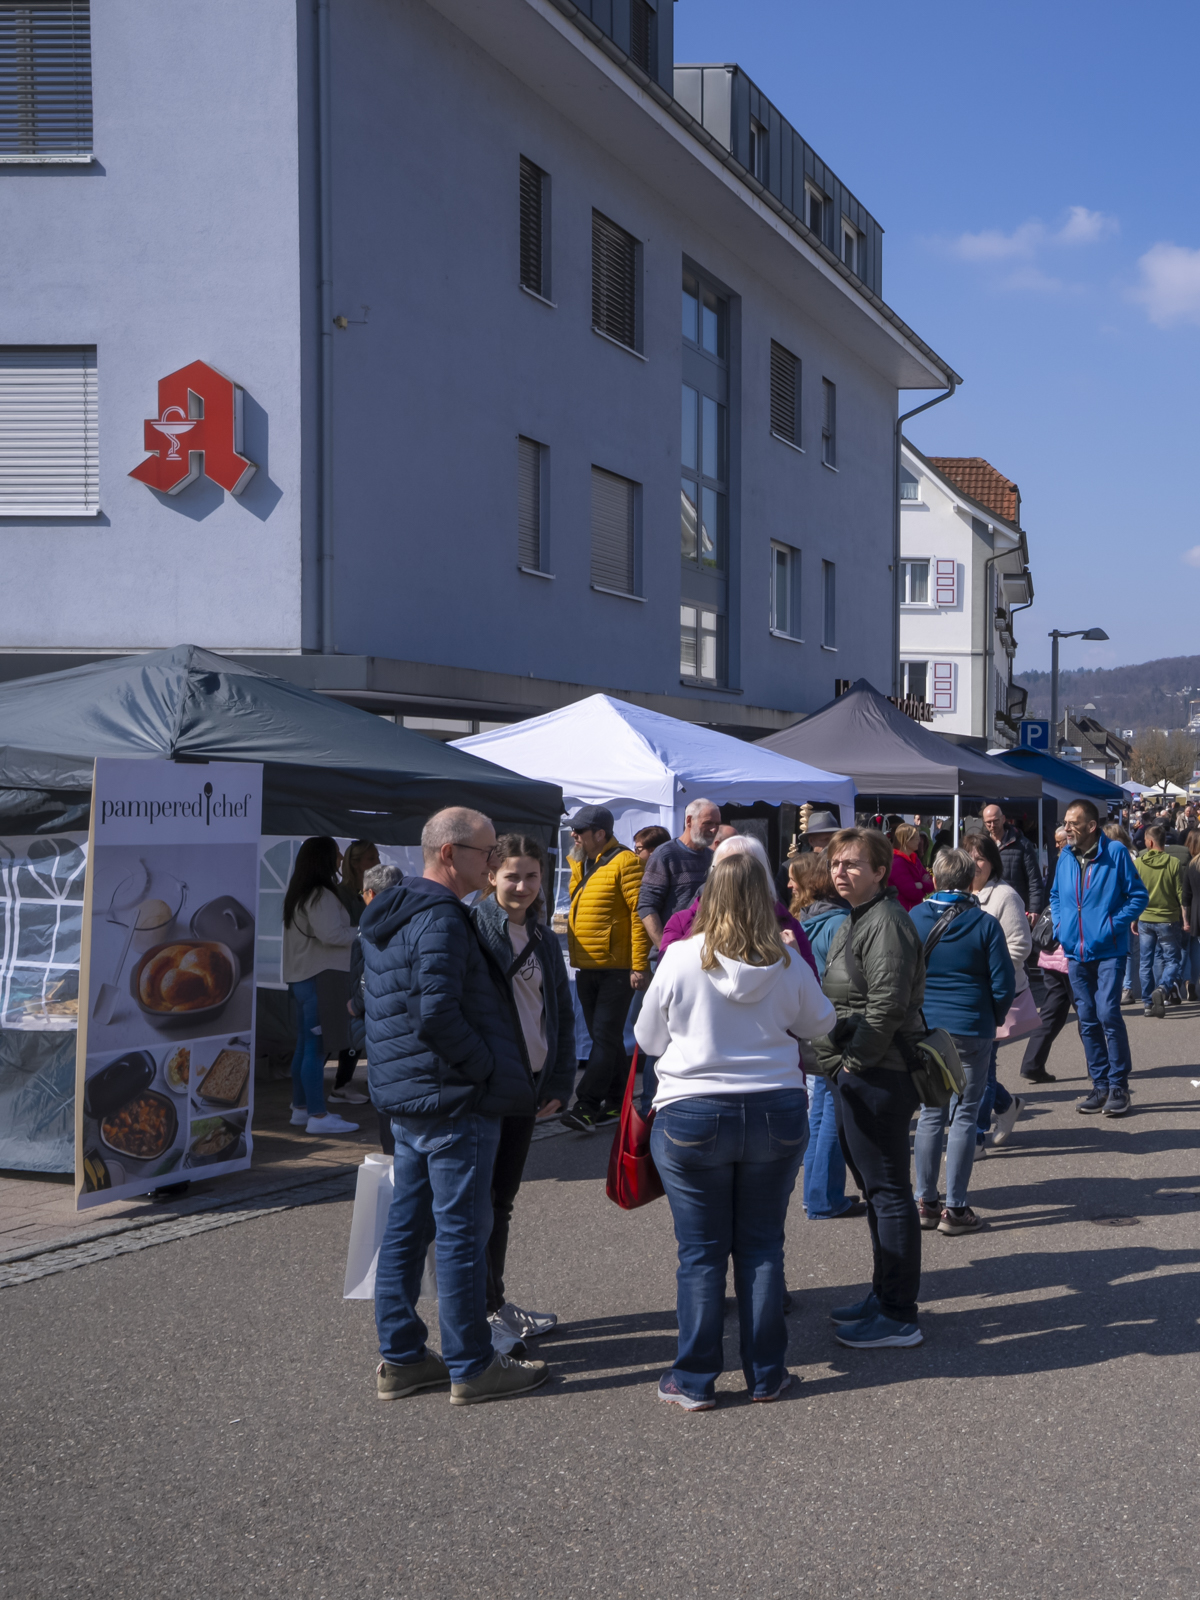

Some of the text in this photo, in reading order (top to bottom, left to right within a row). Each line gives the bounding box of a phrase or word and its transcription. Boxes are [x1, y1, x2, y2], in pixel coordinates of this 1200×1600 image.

[1027, 724, 1042, 746] P
[101, 793, 252, 825] pampered chef
